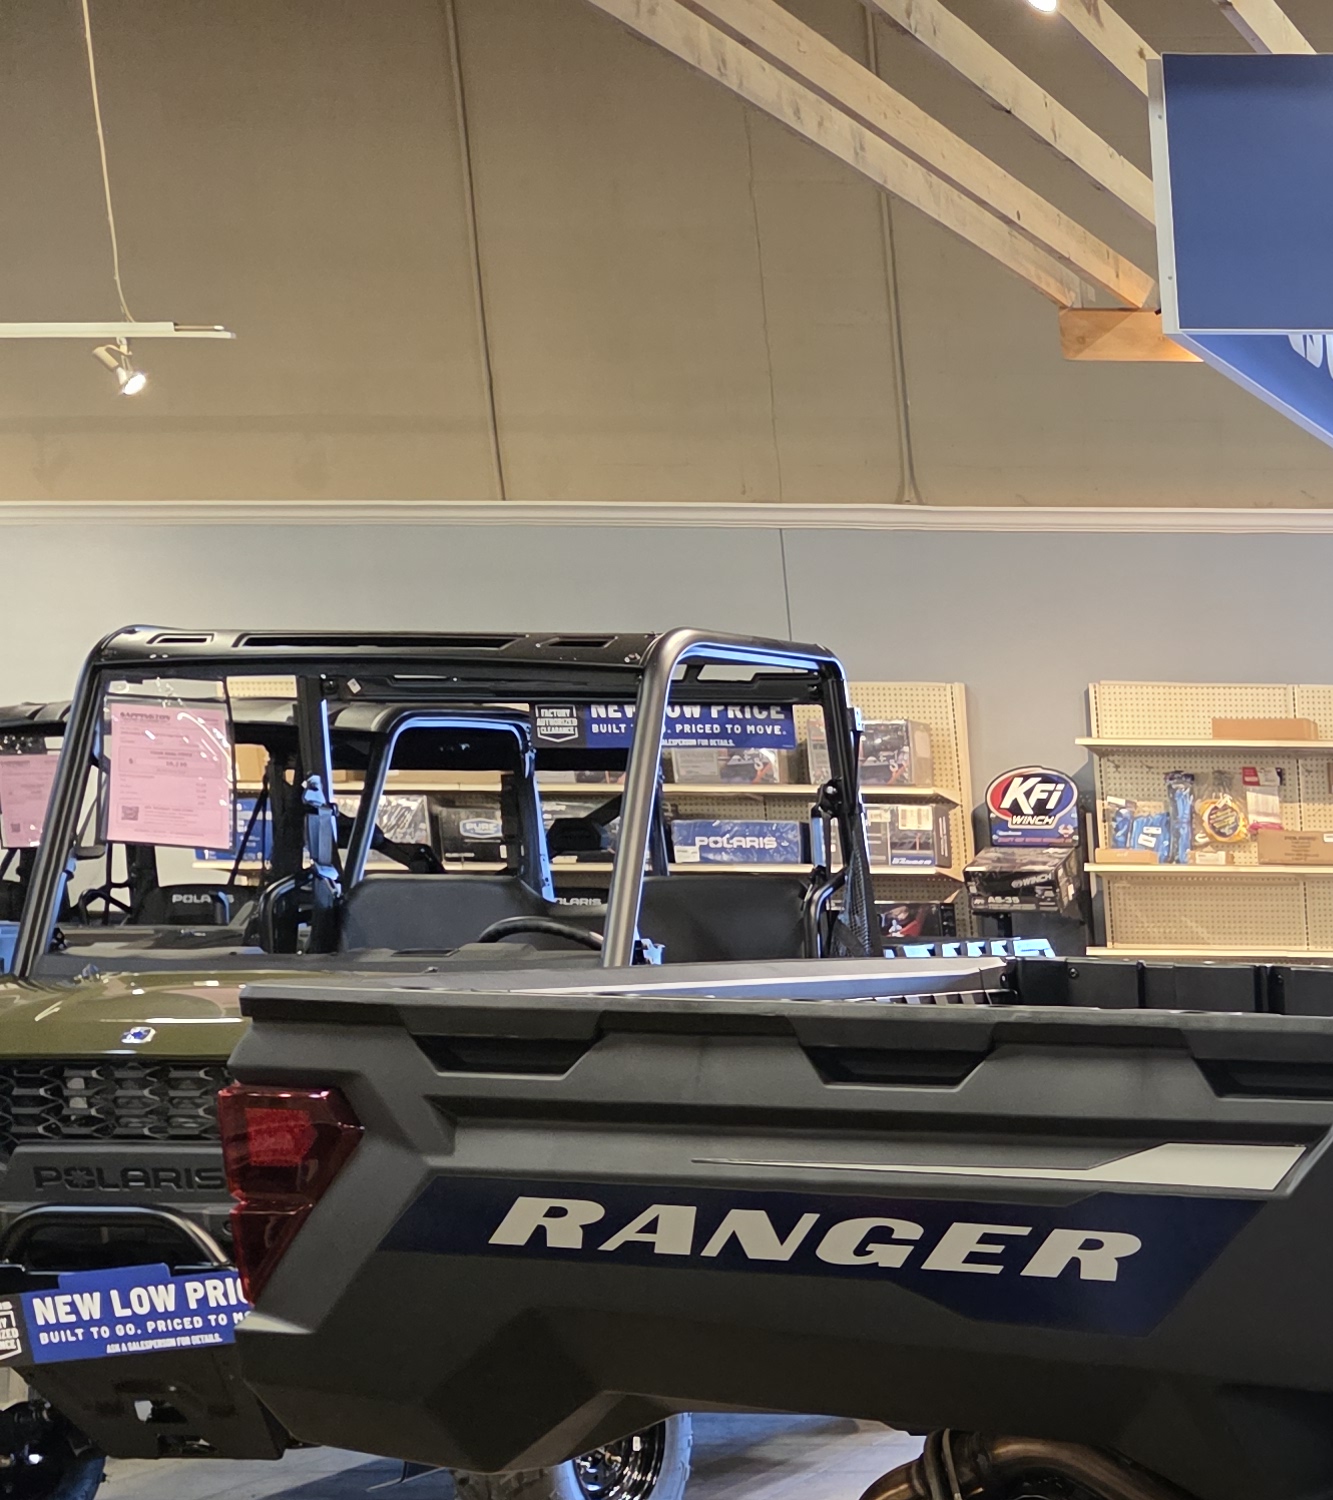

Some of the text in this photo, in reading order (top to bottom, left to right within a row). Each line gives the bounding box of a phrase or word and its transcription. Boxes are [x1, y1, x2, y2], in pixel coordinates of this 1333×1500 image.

[592, 724, 626, 733] BUILT
[676, 724, 721, 734] PRICED
[725, 725, 742, 734] TO
[747, 725, 787, 735] MOVE.
[463, 822, 498, 831] PURE
[695, 836, 778, 850] POLARIS
[32, 1167, 227, 1191] POLARIS
[488, 1196, 1142, 1281] RANGER
[32, 1292, 101, 1326] NEW
[110, 1284, 176, 1318] LOW
[39, 1328, 84, 1345] BUILT
[90, 1325, 110, 1339] TO
[147, 1316, 203, 1334] PRICED
[207, 1313, 228, 1327] TO
